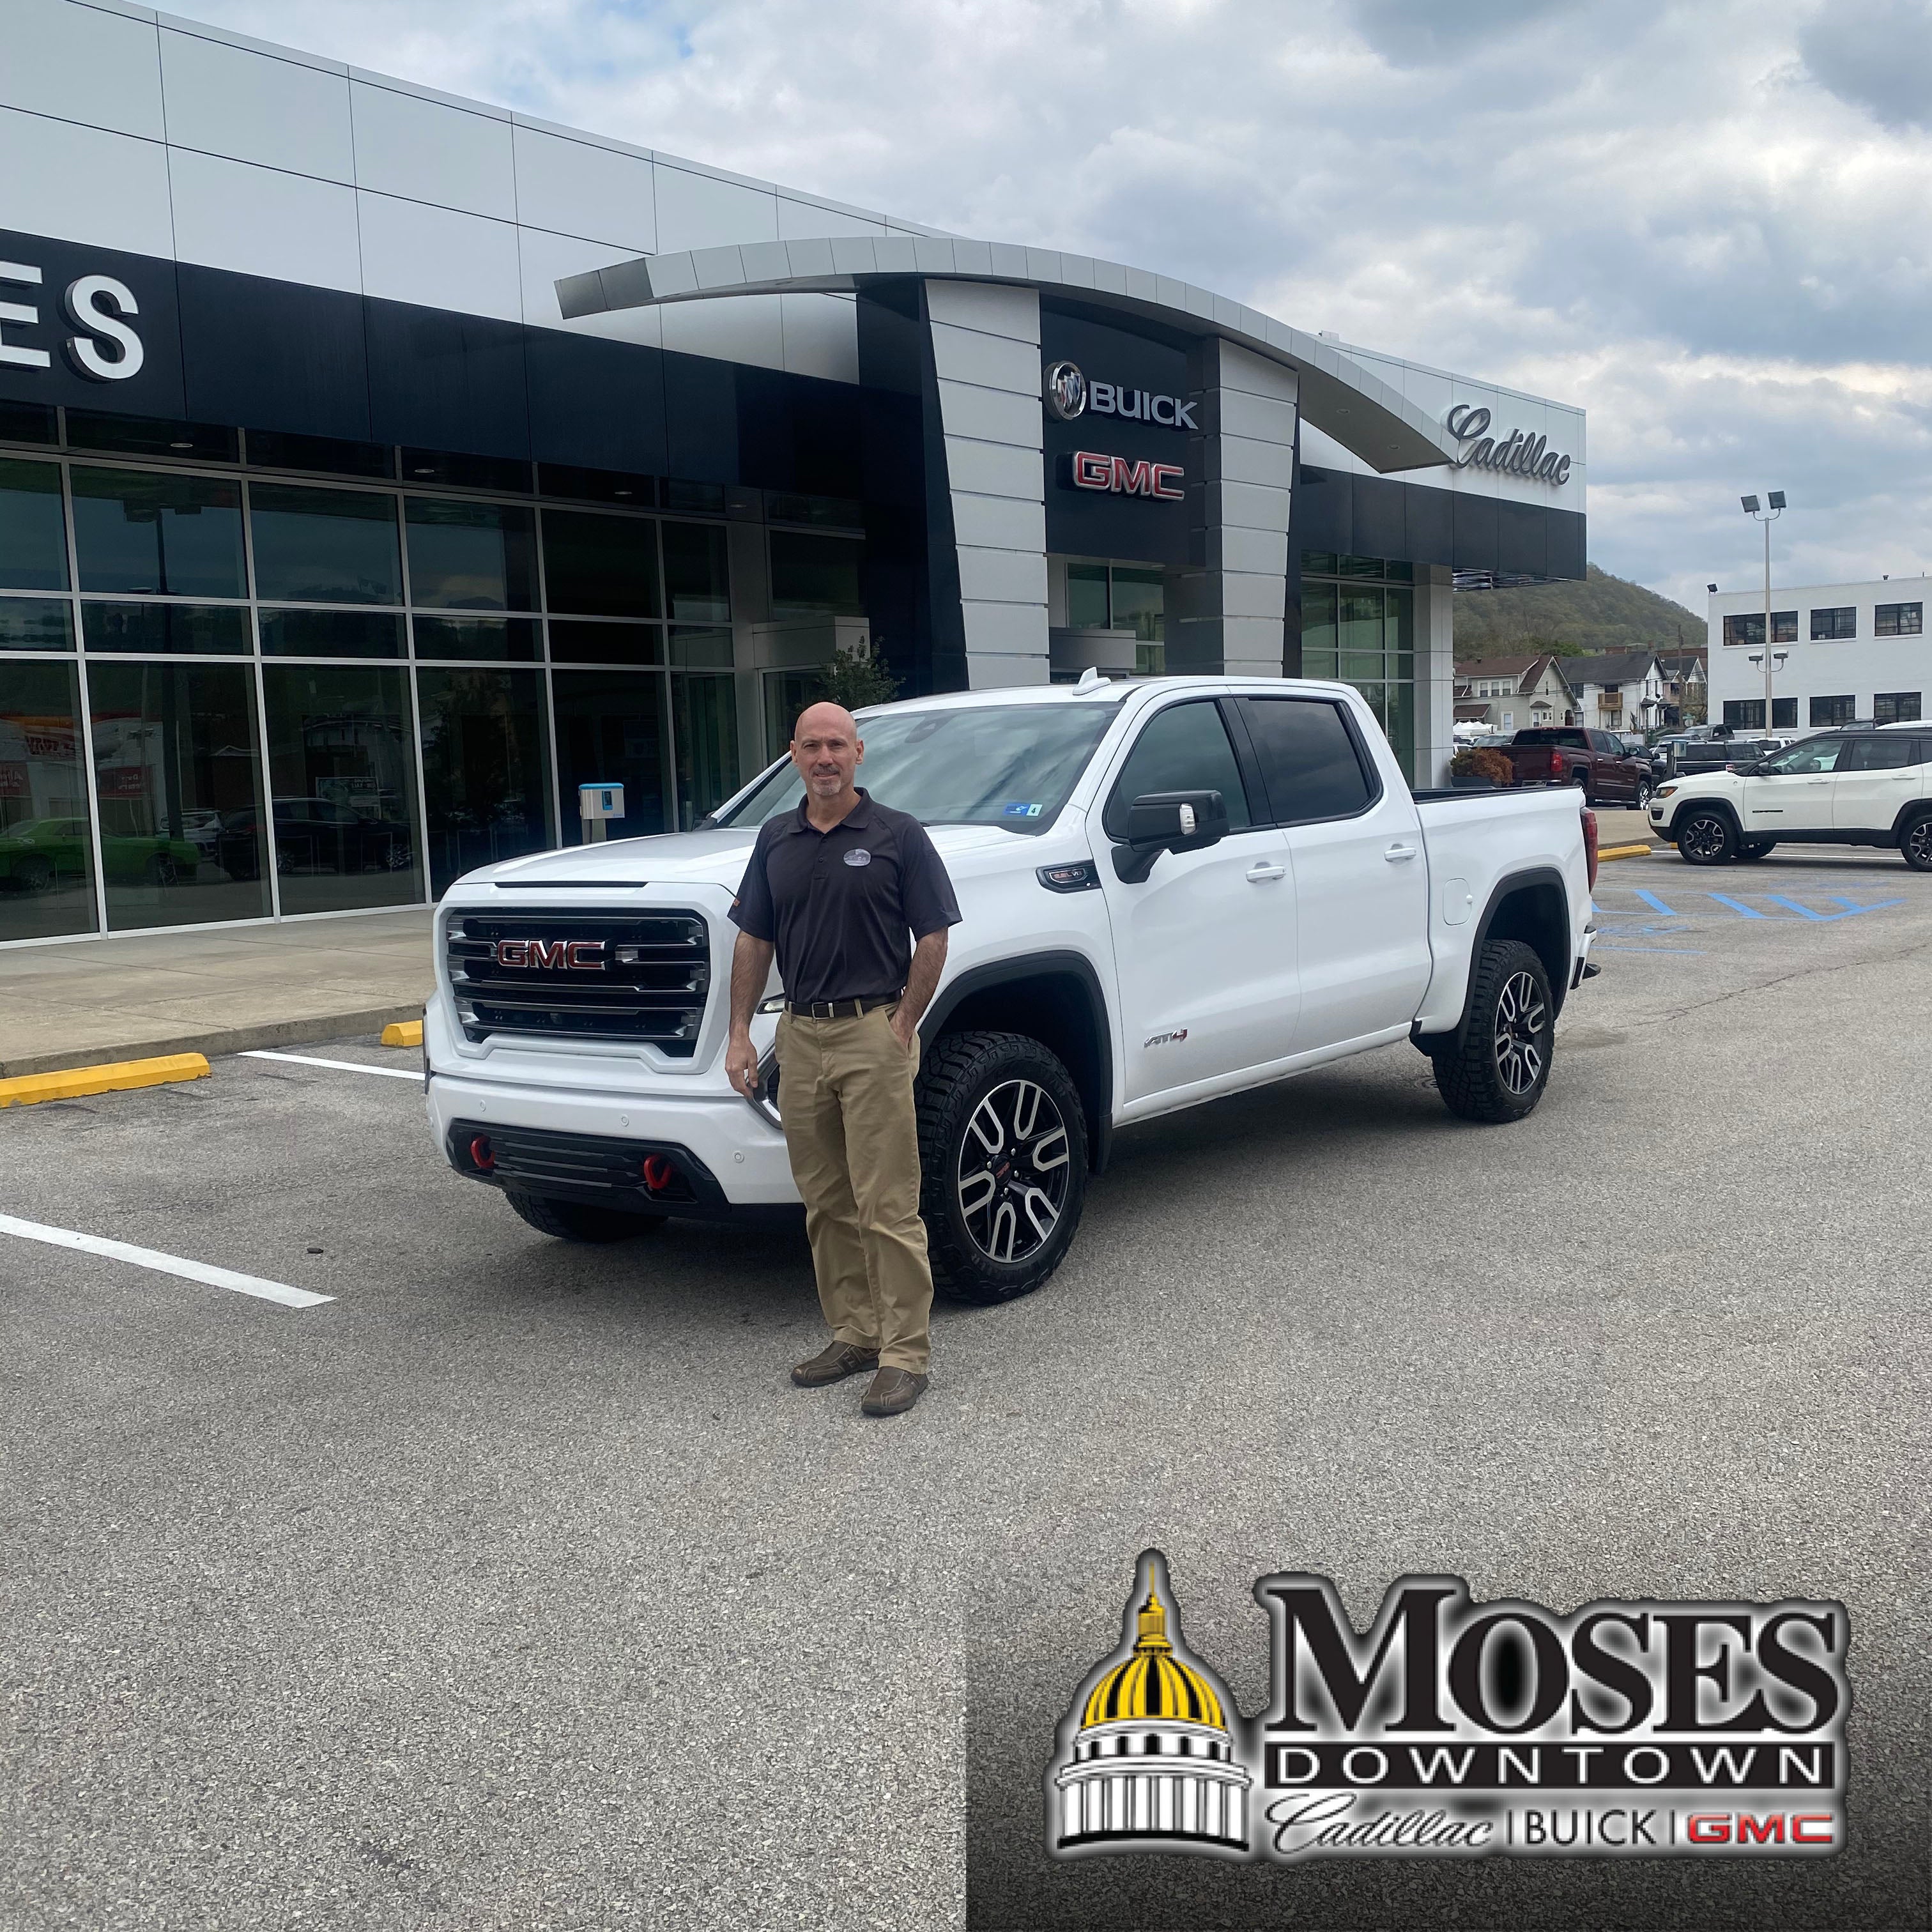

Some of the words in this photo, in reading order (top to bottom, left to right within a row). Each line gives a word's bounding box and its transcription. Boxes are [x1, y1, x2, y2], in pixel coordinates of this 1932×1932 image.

[1090, 381, 1199, 430] BUICK
[1447, 404, 1571, 486] Cadillac
[1073, 451, 1184, 501] GMC
[498, 940, 606, 970] GMC
